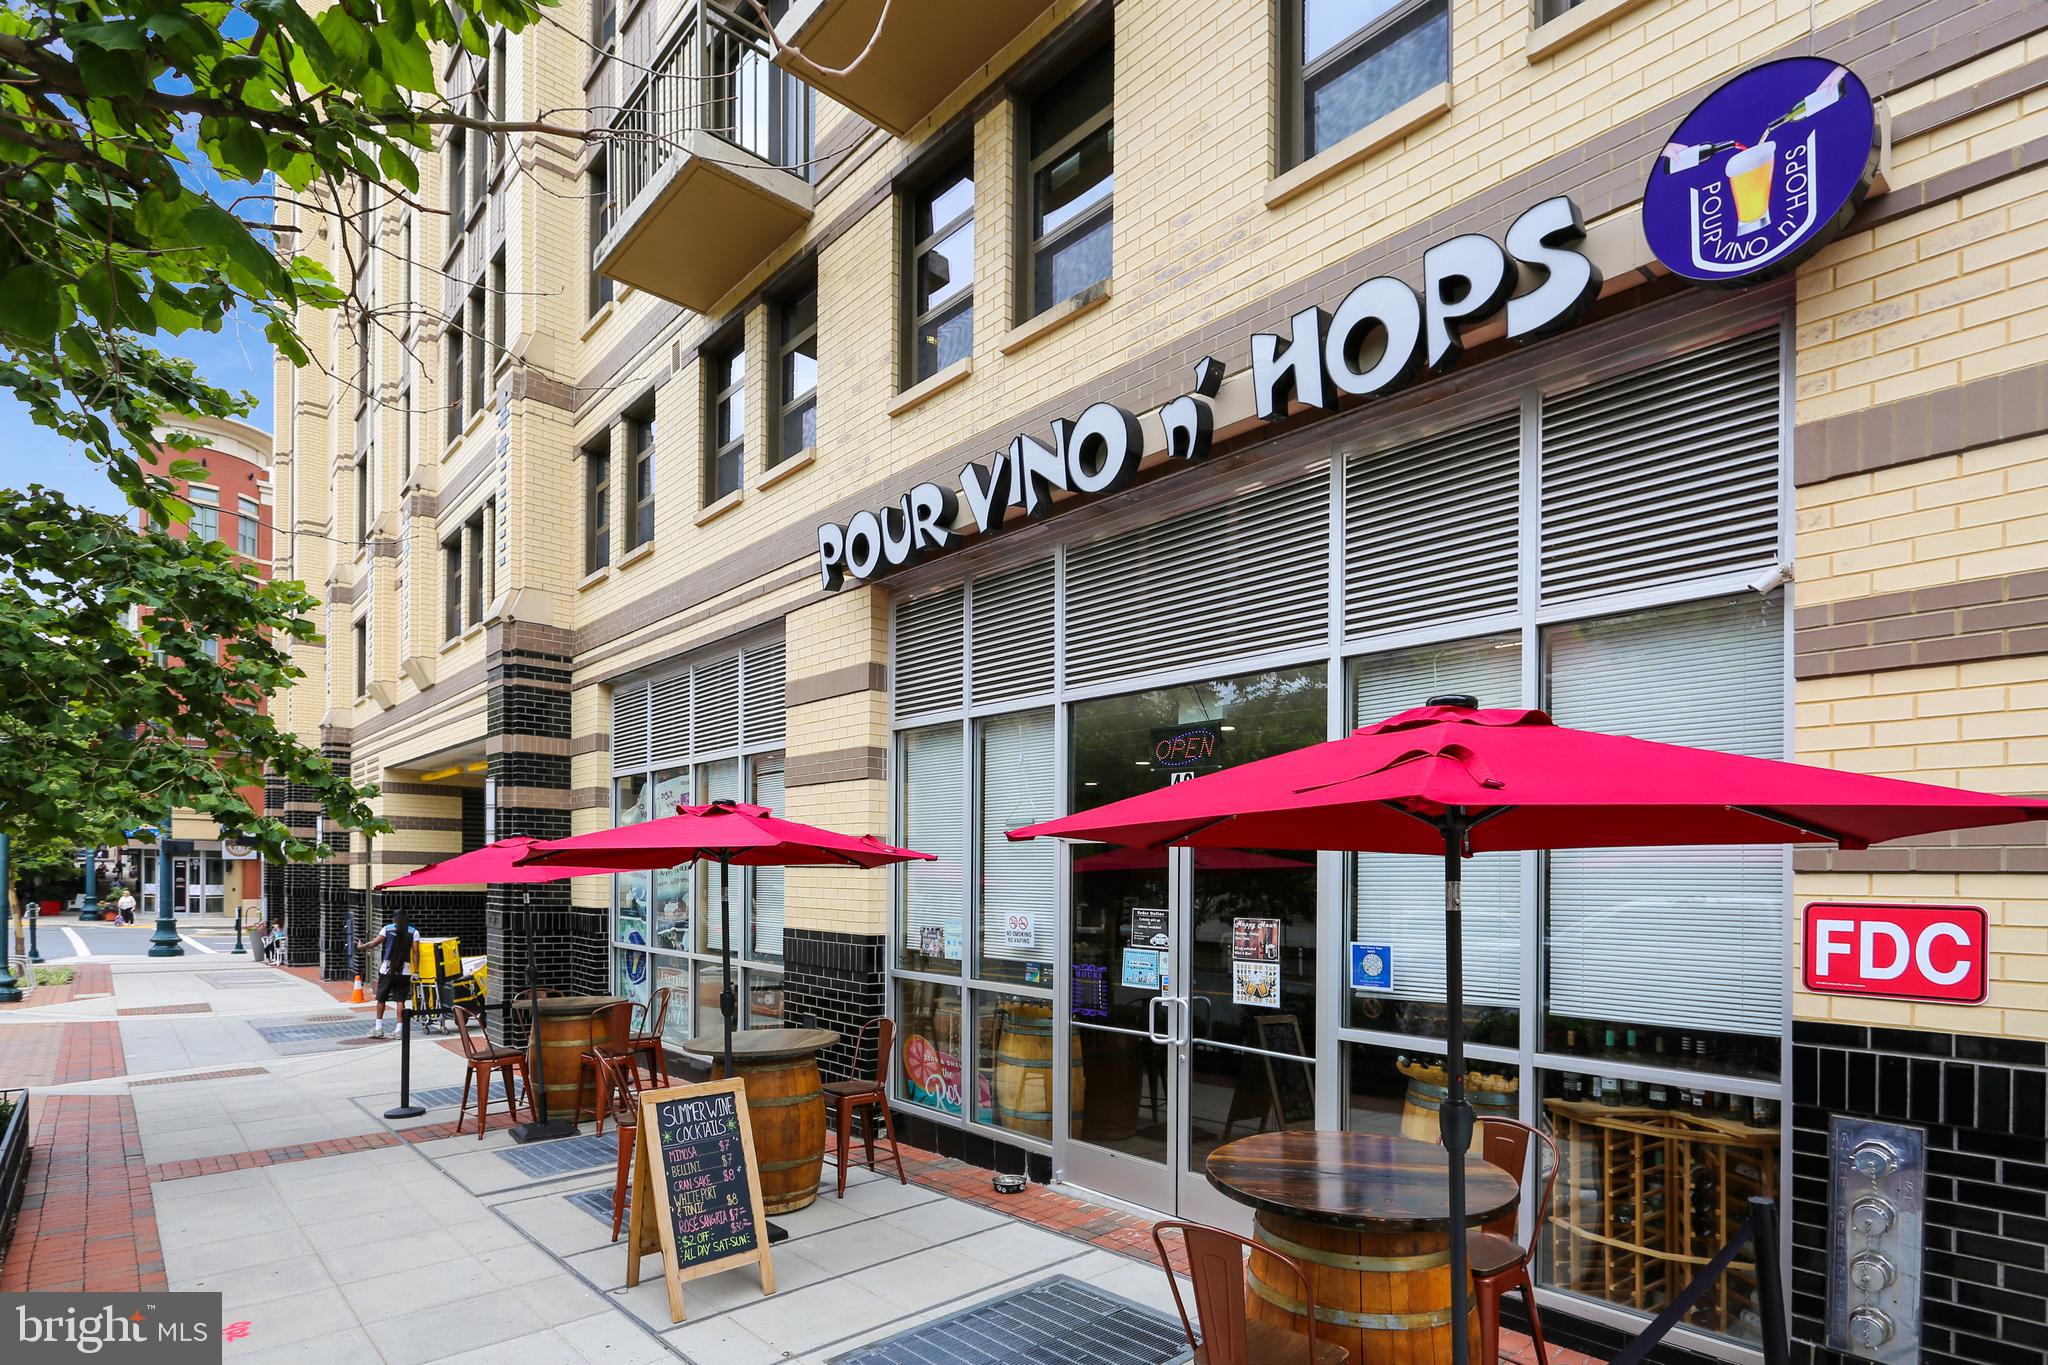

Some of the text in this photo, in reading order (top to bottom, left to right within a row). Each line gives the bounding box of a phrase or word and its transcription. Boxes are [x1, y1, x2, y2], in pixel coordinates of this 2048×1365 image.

[1702, 181, 1723, 245] POUR
[1714, 236, 1768, 261] VINO
[1785, 145, 1807, 211] HOPS
[818, 482, 960, 592] POUR
[958, 401, 1144, 535] VINO
[1250, 195, 1604, 422] HOPS
[1156, 736, 1216, 761] OPEN
[1815, 918, 1972, 986] FDC
[1075, 970, 1102, 979] HOURS
[663, 1096, 735, 1127] SUMMER WINE
[676, 1118, 727, 1143] COCKTAILS
[668, 1139, 730, 1163] MIMOSA $7
[671, 1153, 732, 1178] BELLINI $7
[673, 1168, 735, 1192] CRAN-SAKE $8
[673, 1185, 717, 1208] WHITE PORT
[682, 1201, 707, 1217] TONIC
[726, 1192, 739, 1206] $8
[699, 1209, 729, 1229] SANGRIA
[682, 1231, 710, 1248] $2 OFF
[684, 1235, 747, 1261] ALL DAY SAT-SUN
